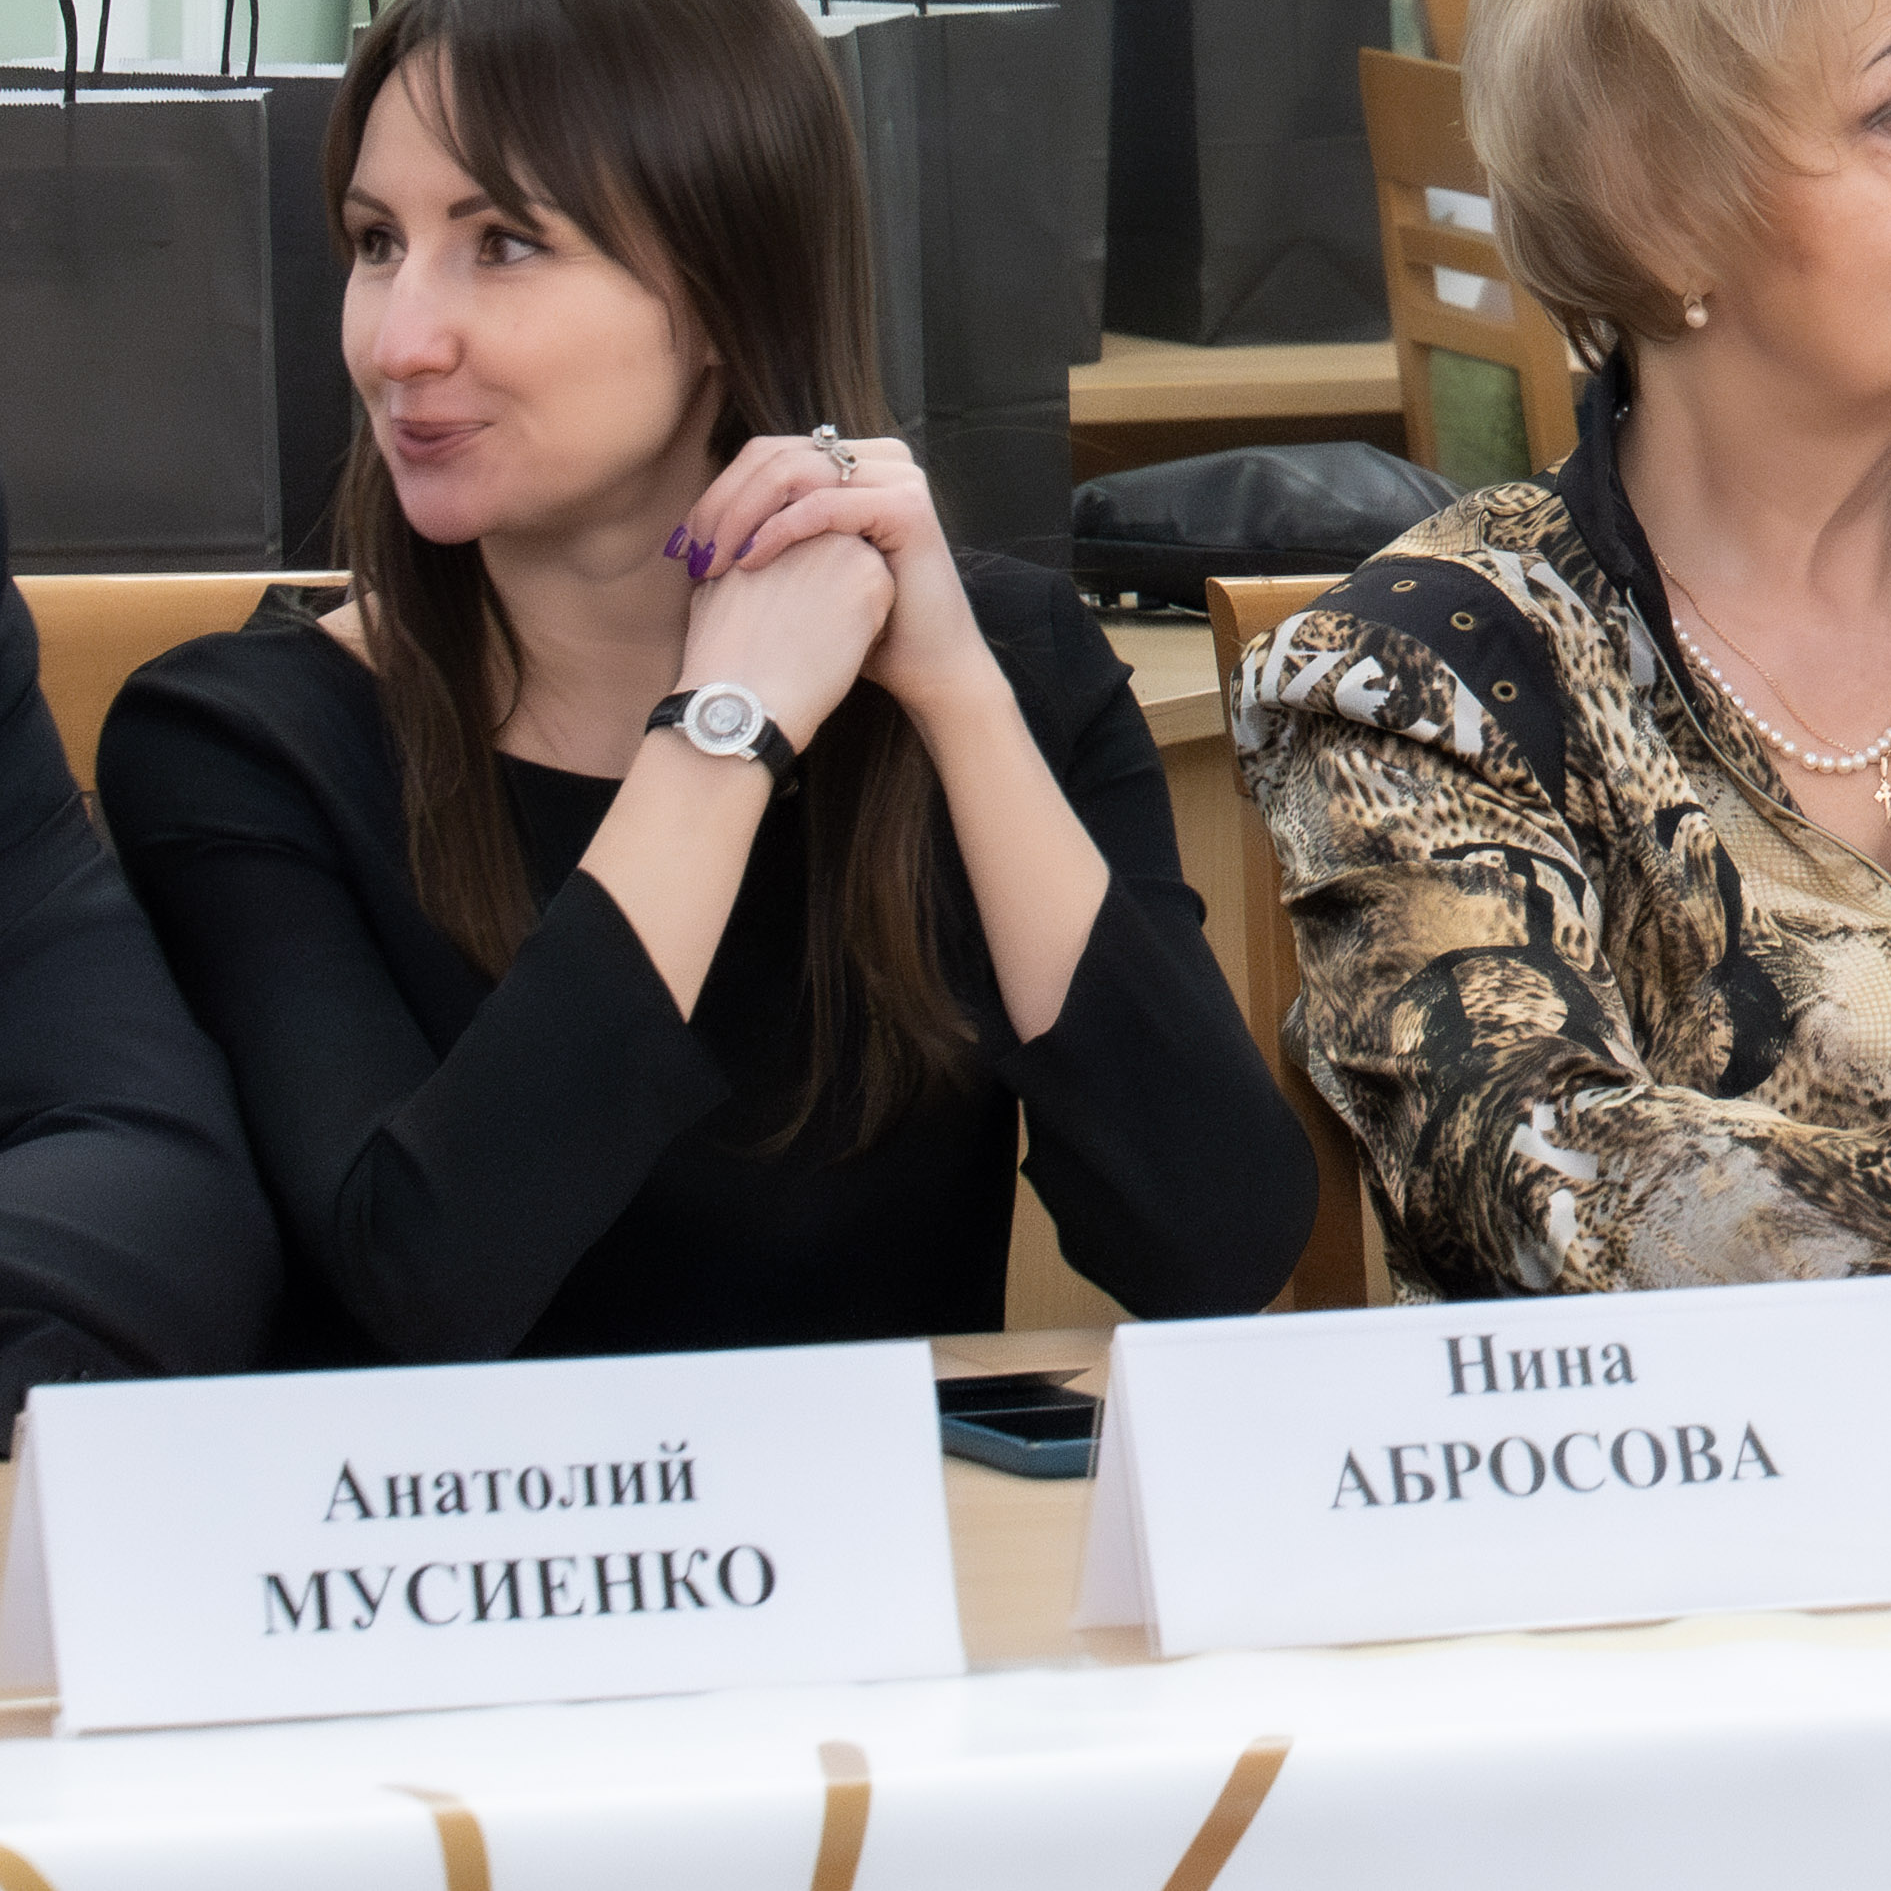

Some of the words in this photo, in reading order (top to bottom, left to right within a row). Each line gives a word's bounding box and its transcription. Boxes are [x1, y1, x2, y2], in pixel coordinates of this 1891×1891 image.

[1442, 1332, 1638, 1398] Нина
[322, 1439, 698, 1524] Анатолий
[1330, 1421, 1782, 1511] АБРОСОВА
[262, 1544, 778, 1636] МУСИЕНКО
